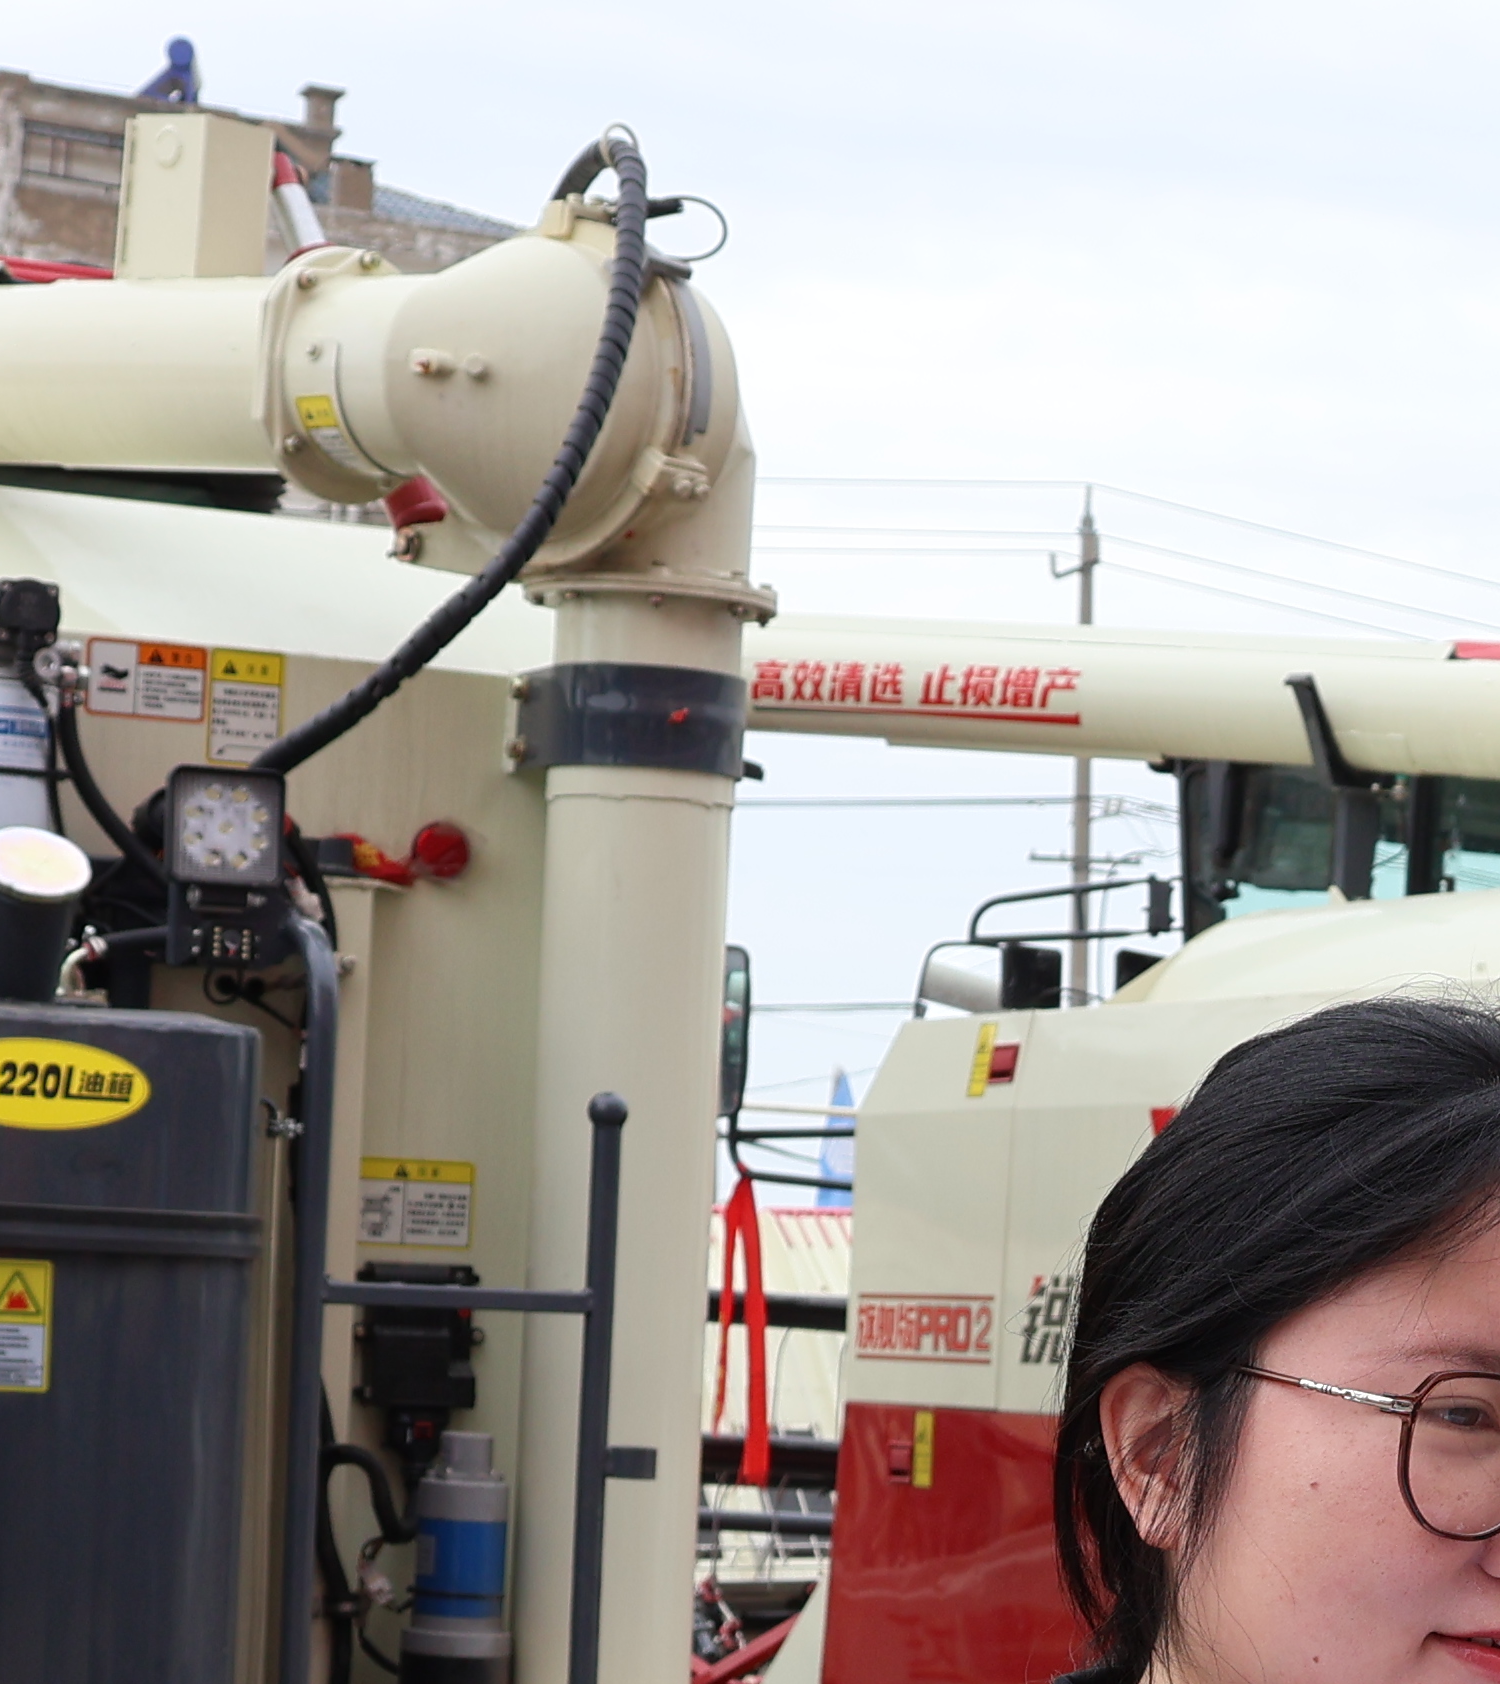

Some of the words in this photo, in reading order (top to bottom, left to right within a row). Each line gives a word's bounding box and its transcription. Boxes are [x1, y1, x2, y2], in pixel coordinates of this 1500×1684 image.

[751, 658, 905, 705] 高效清选
[918, 663, 1083, 709] 止损增产
